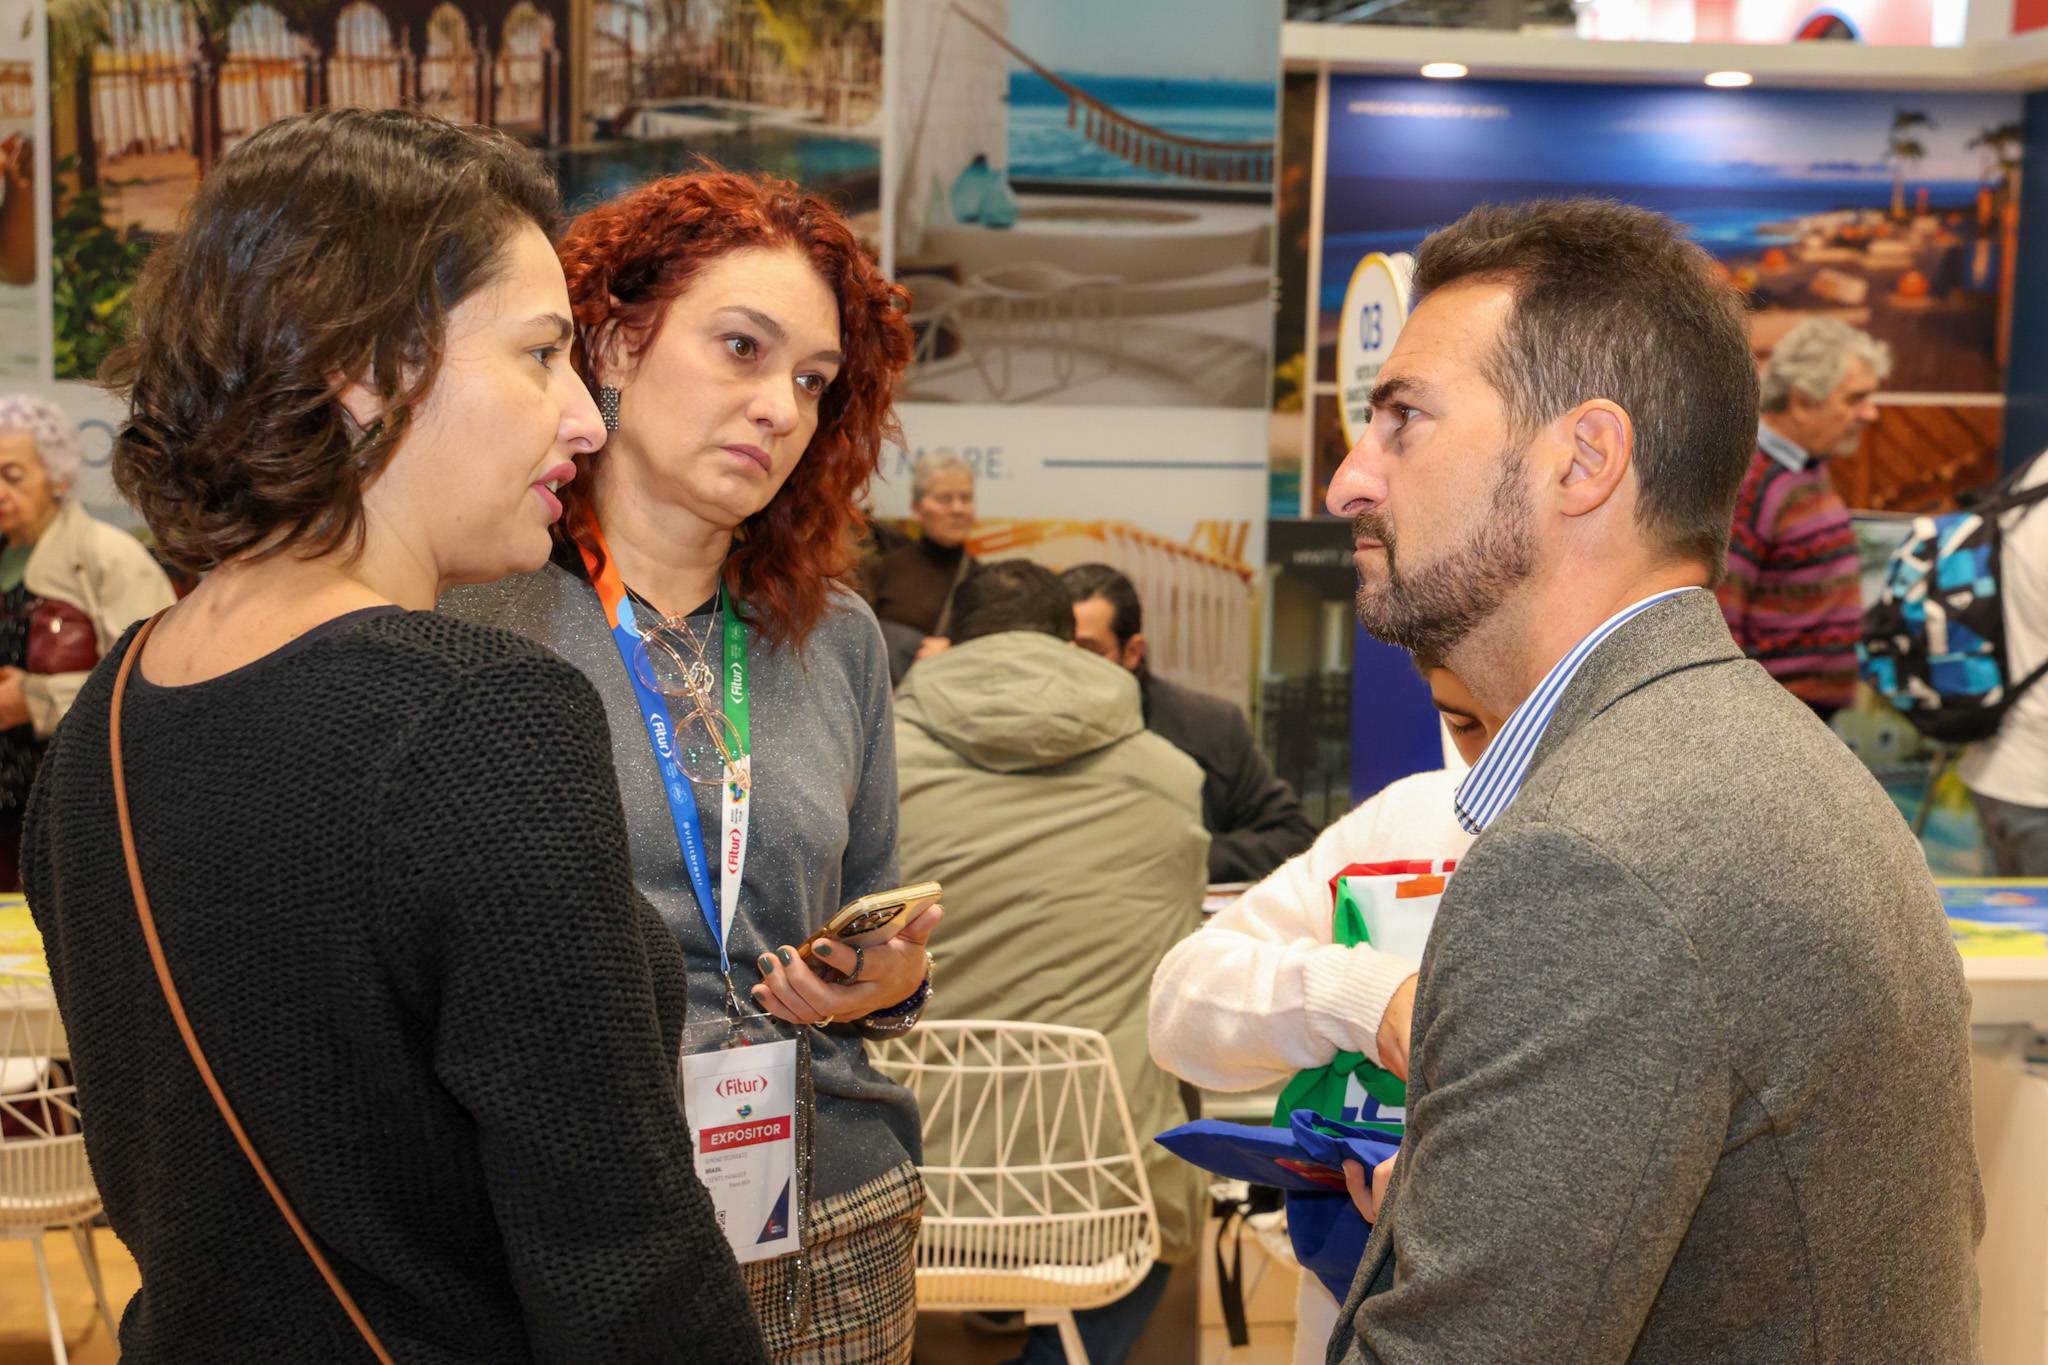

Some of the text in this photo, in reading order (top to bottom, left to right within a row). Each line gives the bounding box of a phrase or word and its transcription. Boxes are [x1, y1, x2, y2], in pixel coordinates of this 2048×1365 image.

[1359, 303, 1383, 350] 03
[683, 821, 703, 886] @visitbrasil
[711, 1123, 781, 1146] EXPOSITOR
[705, 1166, 722, 1174] BRASIL
